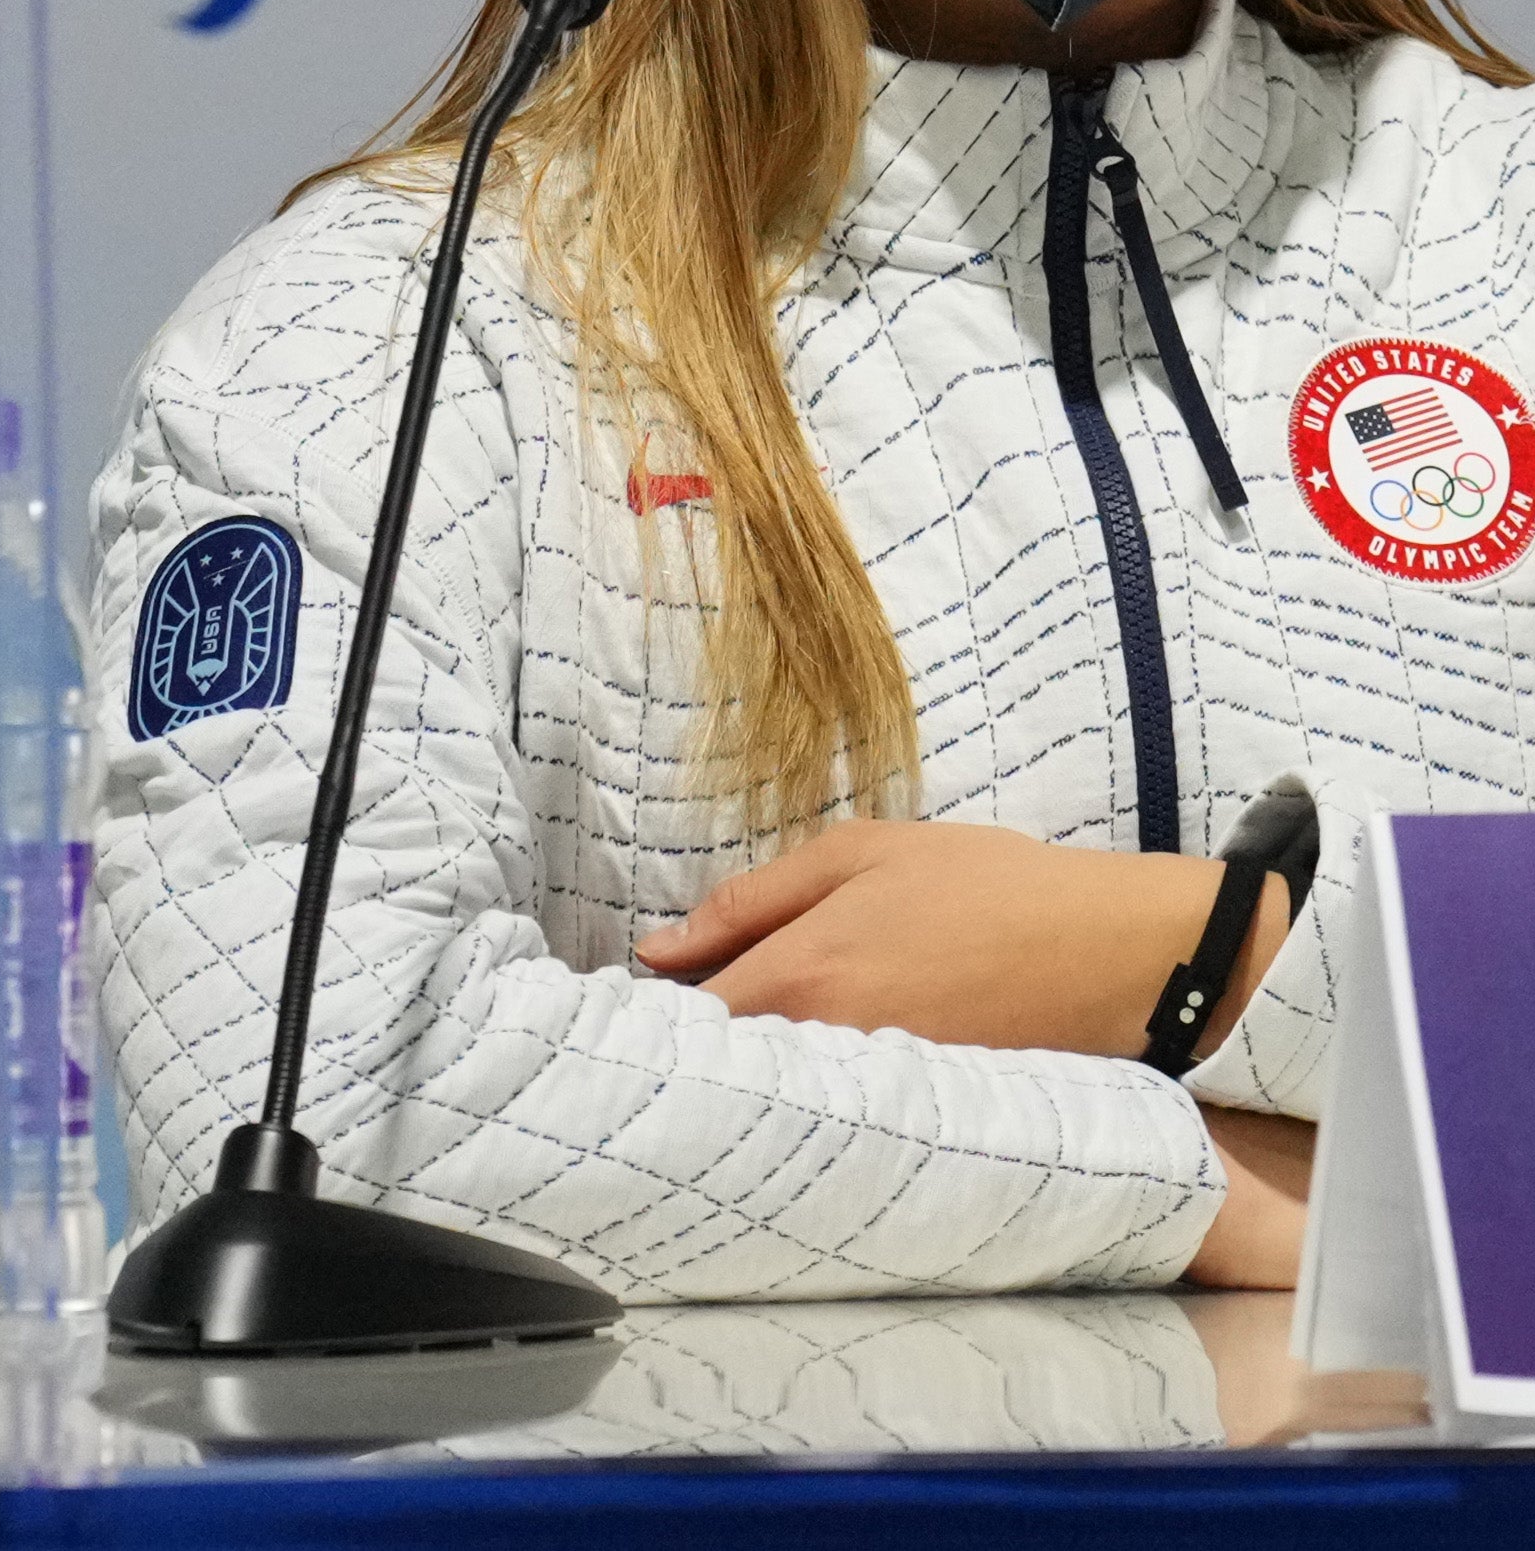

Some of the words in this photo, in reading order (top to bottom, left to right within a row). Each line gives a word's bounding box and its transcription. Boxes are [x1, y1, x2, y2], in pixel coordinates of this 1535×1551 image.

[1302, 354, 1367, 433] UNITED
[1372, 349, 1475, 387] STATES
[1368, 535, 1487, 570] OLYMPIC
[1487, 490, 1534, 549] TEAM
